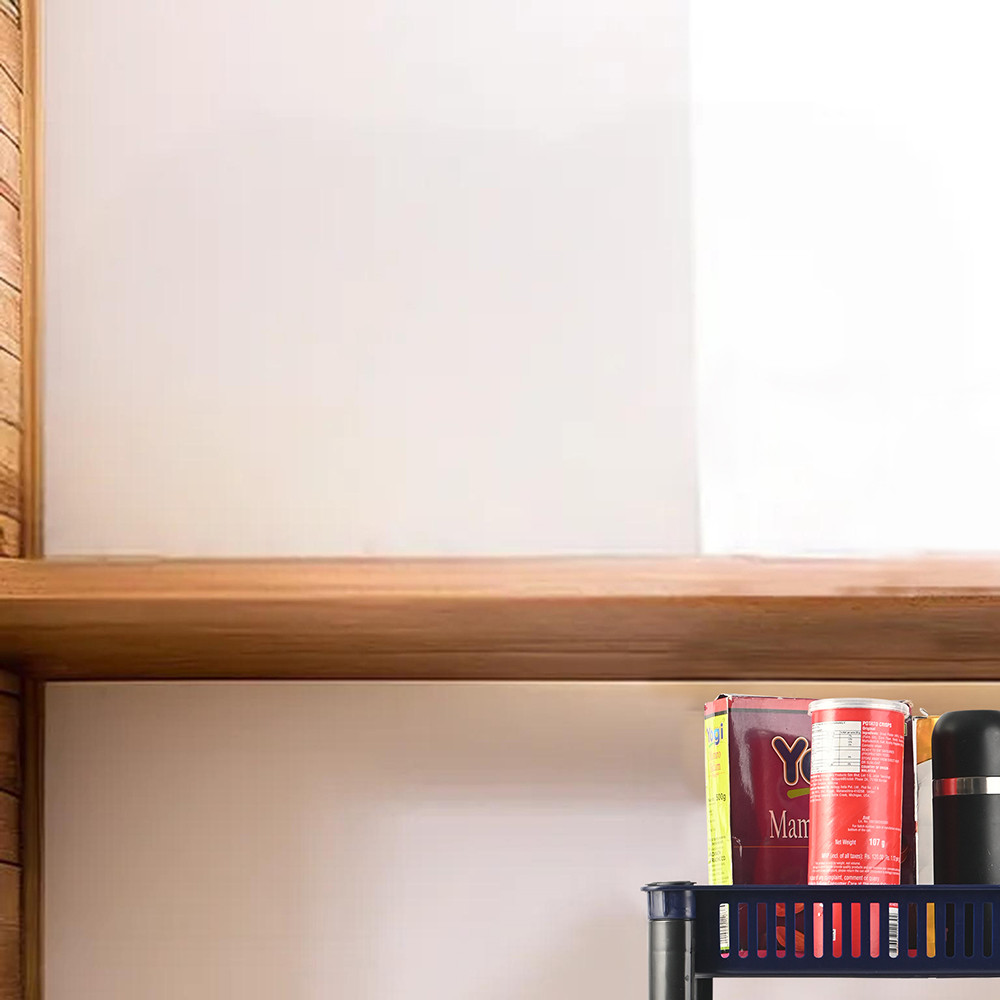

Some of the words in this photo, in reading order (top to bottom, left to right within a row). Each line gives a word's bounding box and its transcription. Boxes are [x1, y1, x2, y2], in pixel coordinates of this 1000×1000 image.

[706, 722, 724, 745] Yogi
[869, 838, 880, 846] 107
[881, 840, 886, 848] g
